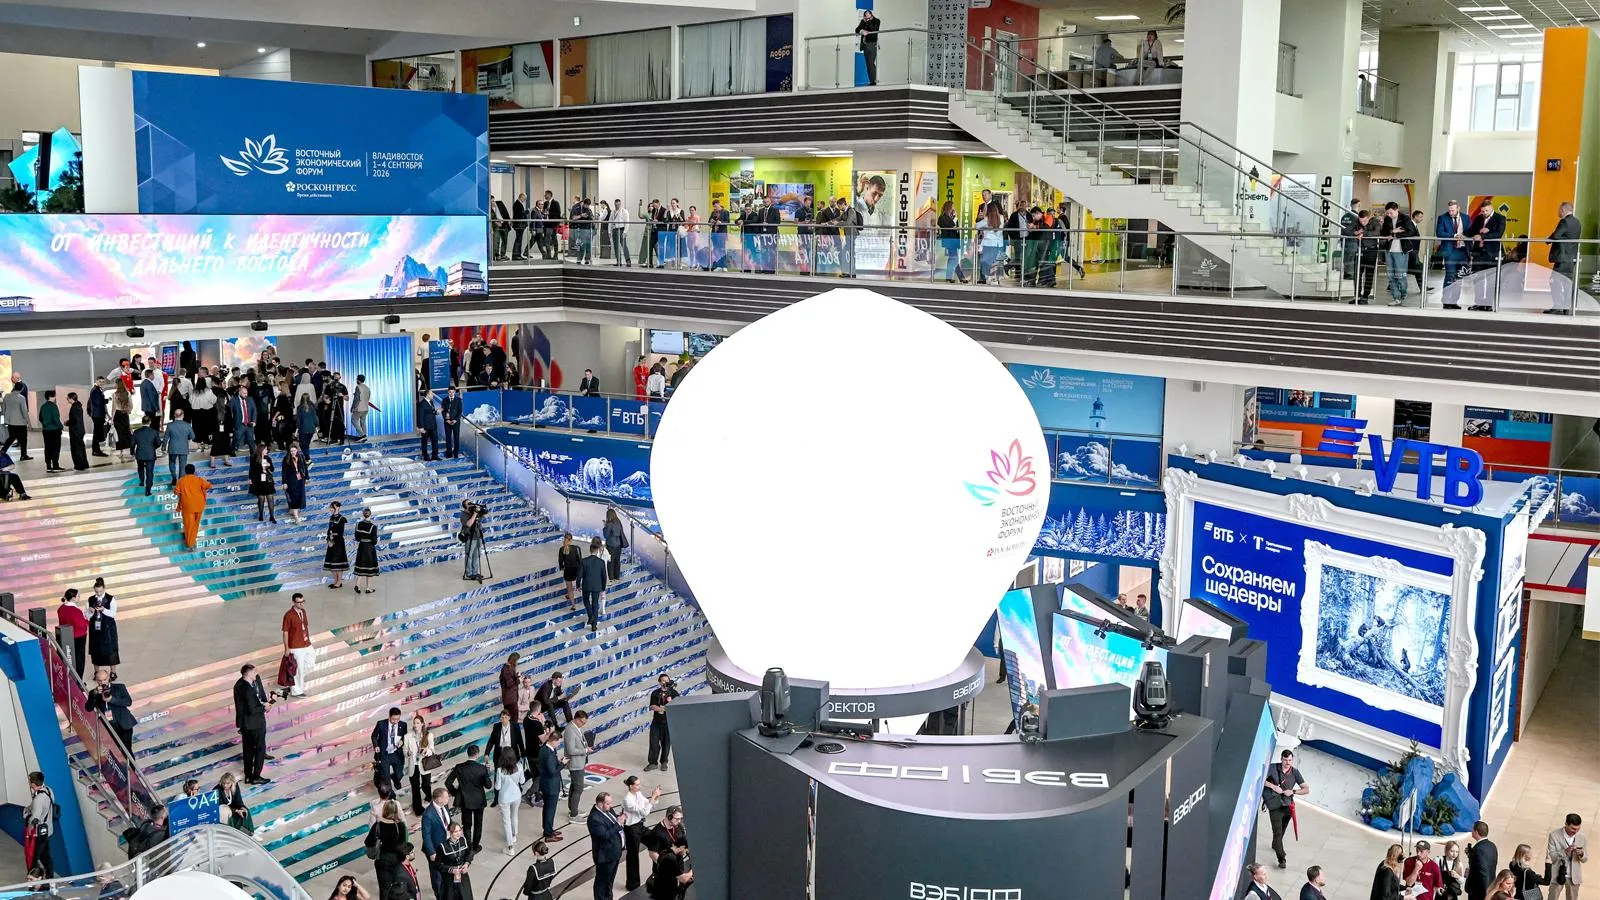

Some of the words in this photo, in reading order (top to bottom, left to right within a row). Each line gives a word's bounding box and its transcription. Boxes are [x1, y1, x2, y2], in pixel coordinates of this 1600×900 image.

[296, 149, 341, 159] ВОСТОЧНЫЙ
[373, 152, 424, 161] ВЛАДИВОСТОК
[296, 159, 361, 168] ЭКОНОМИЧЕСКИЙ
[388, 162, 423, 170] СЕНТЯБРЯ
[296, 168, 324, 176] ФОРУМ
[373, 170, 390, 178] 2026
[296, 183, 357, 192] РОСКОНГРЕСС
[898, 172, 909, 269] РОСНЕФТЬ
[50, 233, 74, 253] ОТ
[90, 229, 214, 252] ИНВЕСТИЦИЙ
[224, 233, 237, 250] К
[246, 231, 371, 251] ИДЕНТИЧНОСТИ
[130, 255, 224, 277] ДАЛЬНЕГО
[236, 253, 309, 273] ВОСТОКА
[623, 412, 645, 426] ВТБ
[1368, 434, 1484, 508] VTB
[998, 527, 1024, 539] ФОРУМ
[1213, 527, 1234, 543] ВТБ
[197, 538, 227, 549] БЛАГО
[205, 547, 237, 558] СОСТО
[213, 557, 240, 568] ЯНИЮ
[1202, 556, 1296, 598] Сохраняем
[1205, 579, 1282, 613] шедевры
